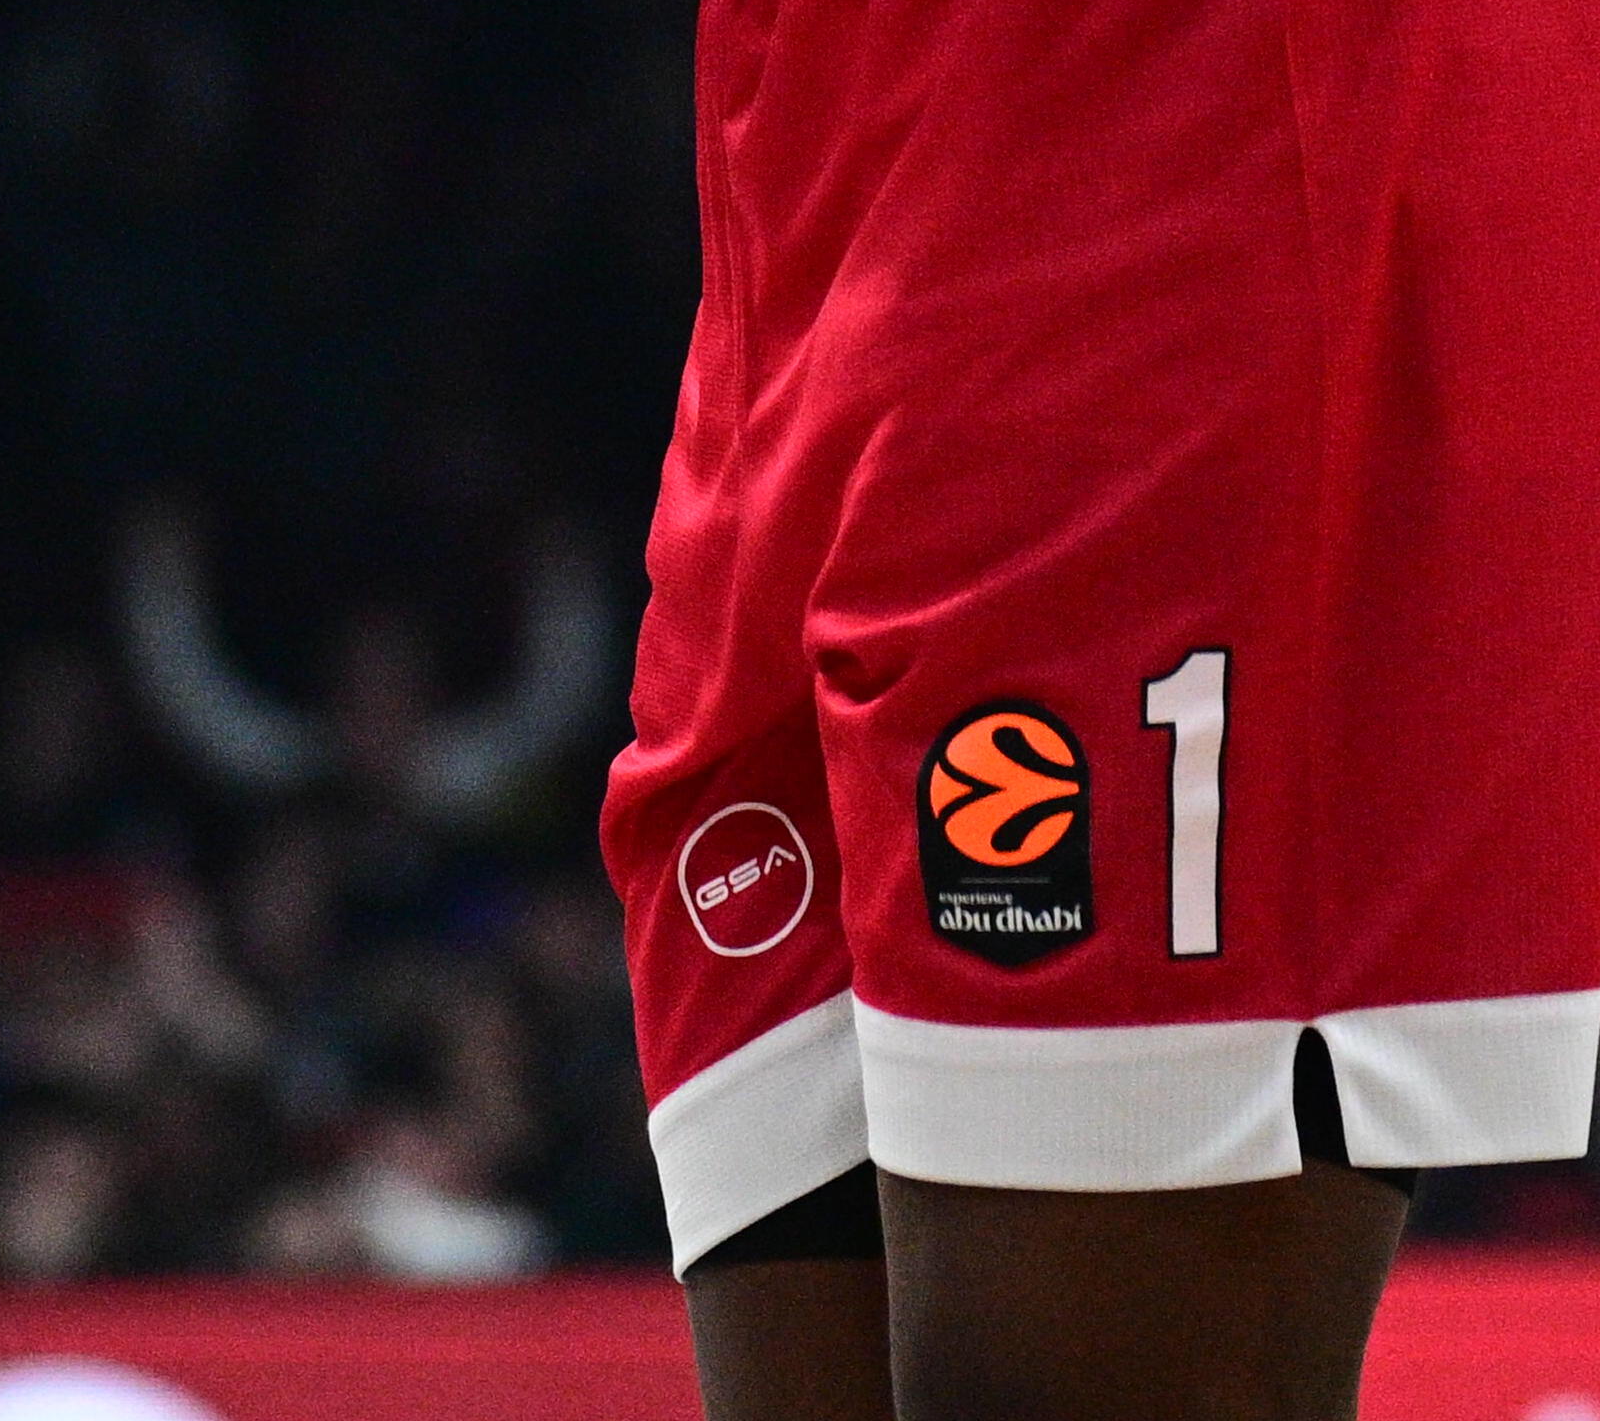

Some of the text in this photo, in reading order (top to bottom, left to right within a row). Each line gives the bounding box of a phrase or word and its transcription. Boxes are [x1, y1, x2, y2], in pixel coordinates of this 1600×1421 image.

[1141, 646, 1231, 960] 1
[696, 845, 797, 911] GSA
[939, 903, 1082, 932] abu dhabi
